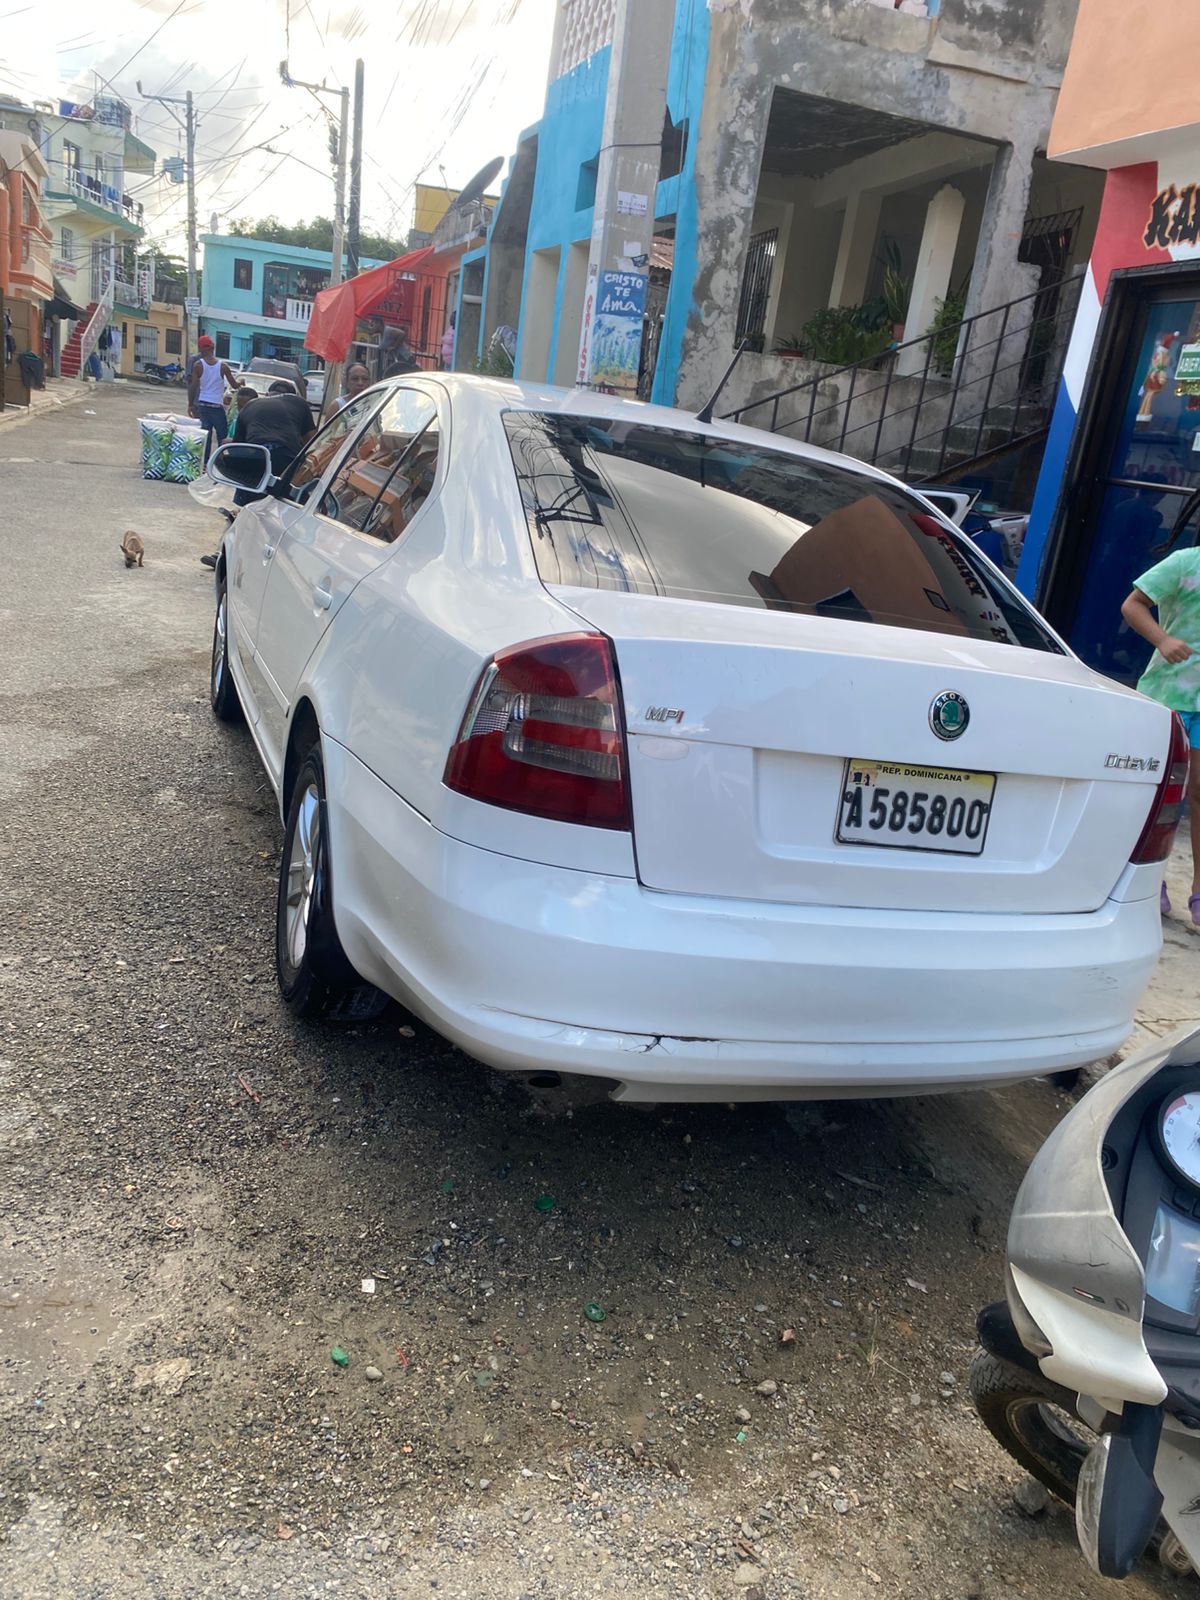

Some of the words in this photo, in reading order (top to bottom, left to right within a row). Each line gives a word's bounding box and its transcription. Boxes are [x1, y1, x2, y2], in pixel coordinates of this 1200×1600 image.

[604, 273, 643, 289] CRISTO
[614, 286, 632, 298] TE
[645, 706, 684, 724] MPI
[882, 766, 901, 776] REP.
[904, 768, 963, 783] DOMINICANA
[845, 787, 984, 839] A585800
